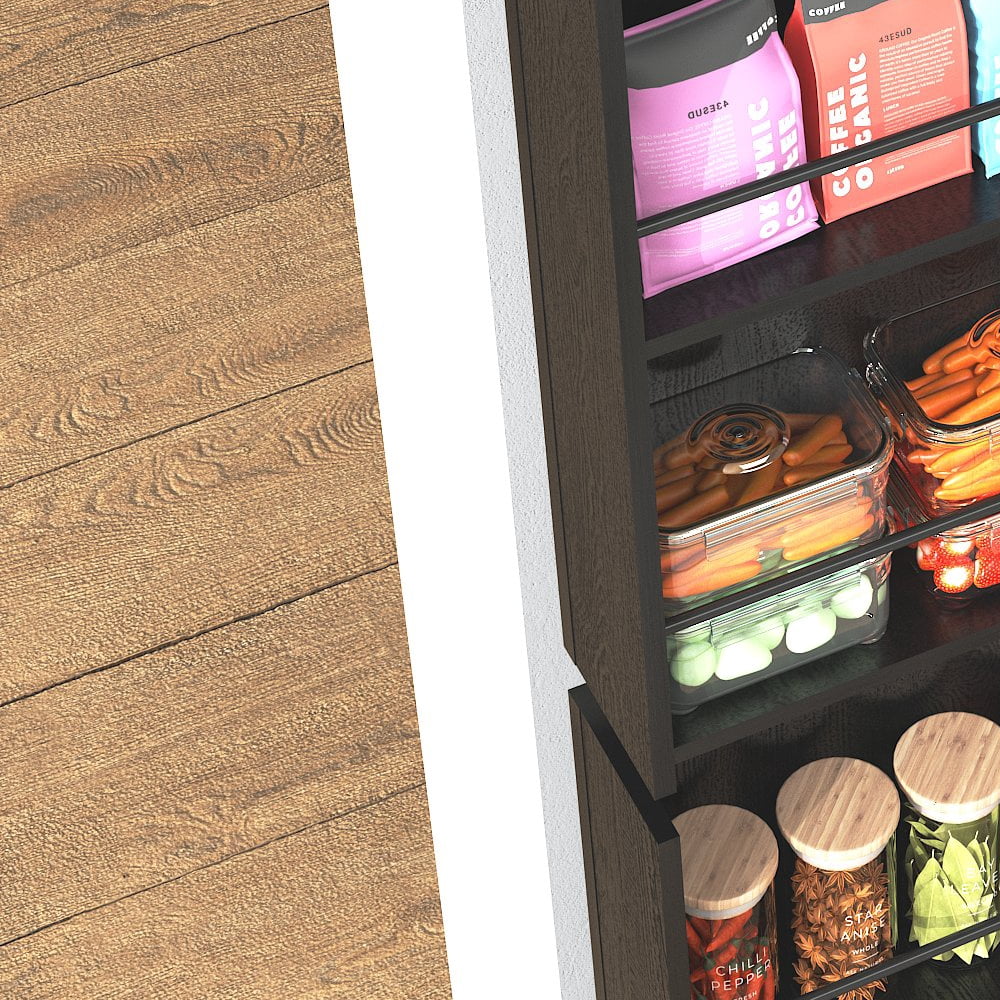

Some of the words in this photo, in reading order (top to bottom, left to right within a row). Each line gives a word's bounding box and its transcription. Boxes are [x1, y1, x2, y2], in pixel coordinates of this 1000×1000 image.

[879, 27, 912, 43] 43ESUD
[844, 903, 883, 927] STAR
[840, 915, 886, 942] ANISE
[851, 941, 879, 956] WHOLE
[715, 946, 767, 977] CHILLI
[711, 958, 771, 991] PEPPER
